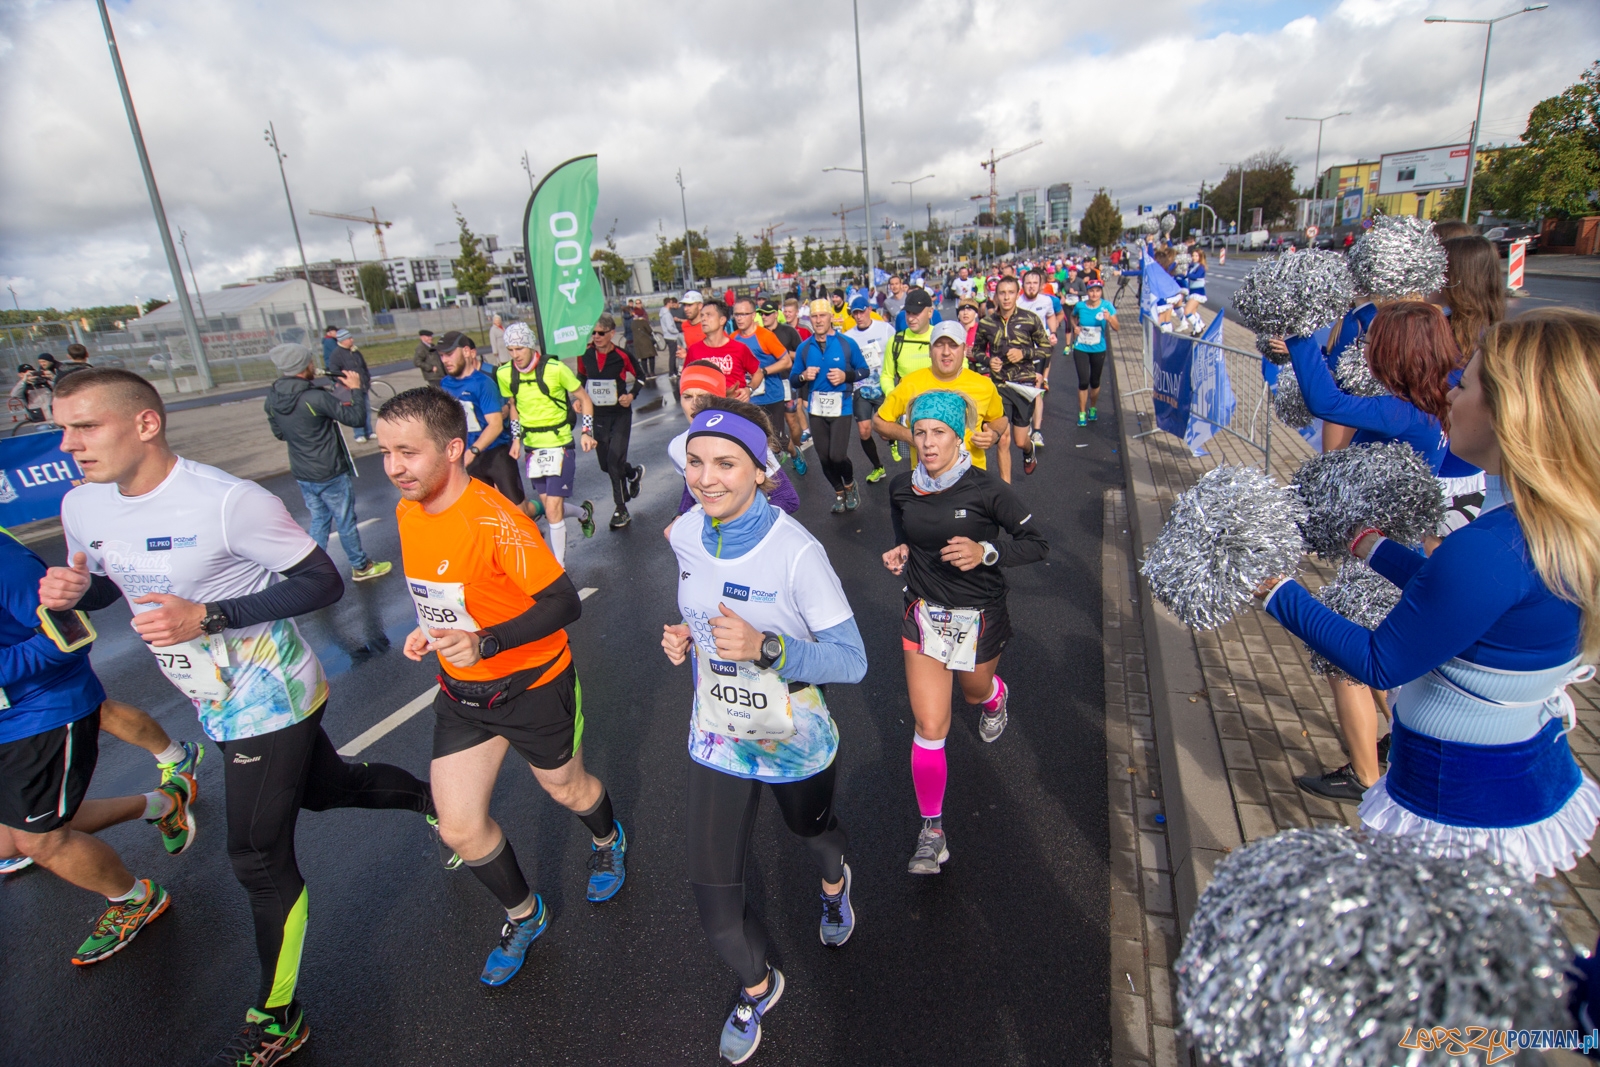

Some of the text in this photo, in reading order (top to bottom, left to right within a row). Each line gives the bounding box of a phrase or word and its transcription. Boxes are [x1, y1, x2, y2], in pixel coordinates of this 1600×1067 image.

[550, 211, 583, 304] 4:00
[16, 460, 74, 488] LECH
[111, 563, 137, 573] SIŁA
[123, 574, 172, 584] ODWAGA
[725, 586, 748, 598] 17.PKO
[711, 663, 735, 673] 17.PKO
[710, 683, 768, 710] 4030
[726, 708, 751, 719] Kasia
